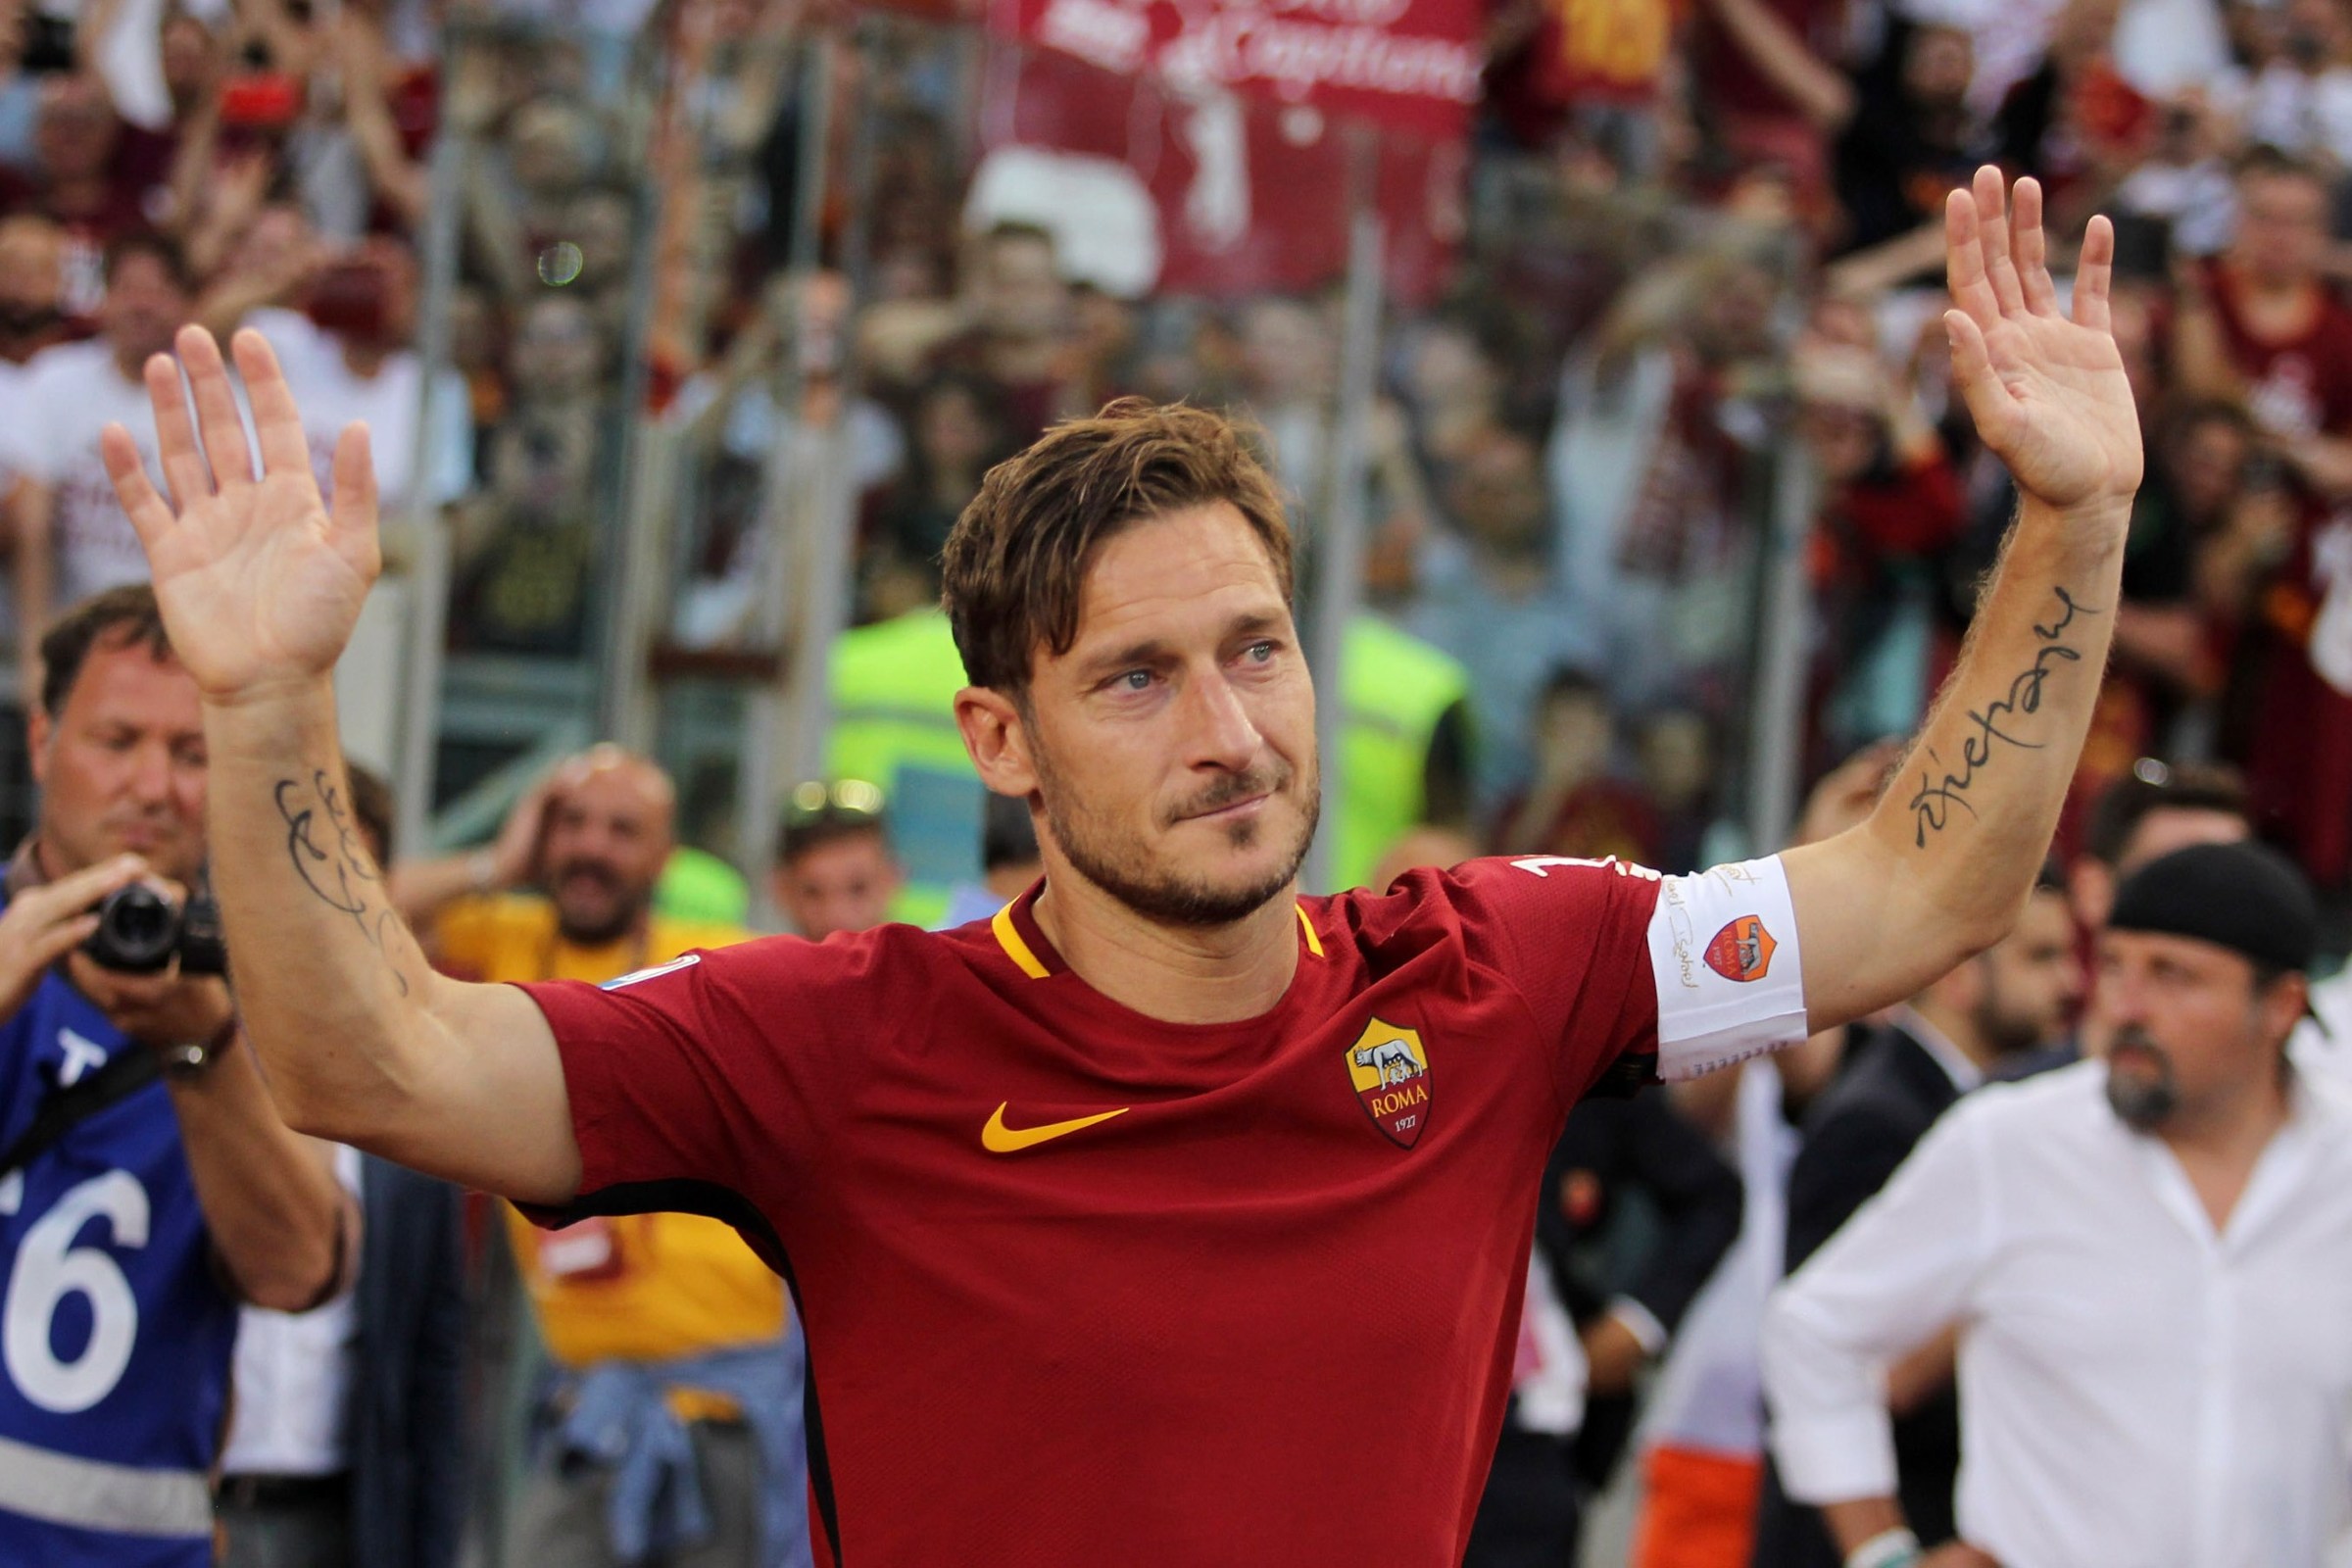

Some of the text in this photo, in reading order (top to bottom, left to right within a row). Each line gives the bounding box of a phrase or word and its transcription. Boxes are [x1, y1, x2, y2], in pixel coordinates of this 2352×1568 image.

[1722, 930, 1738, 976] ROMA
[1372, 1084, 1429, 1118] ROMA
[1395, 1114, 1417, 1133] 1927
[0, 1166, 151, 1414] 6
